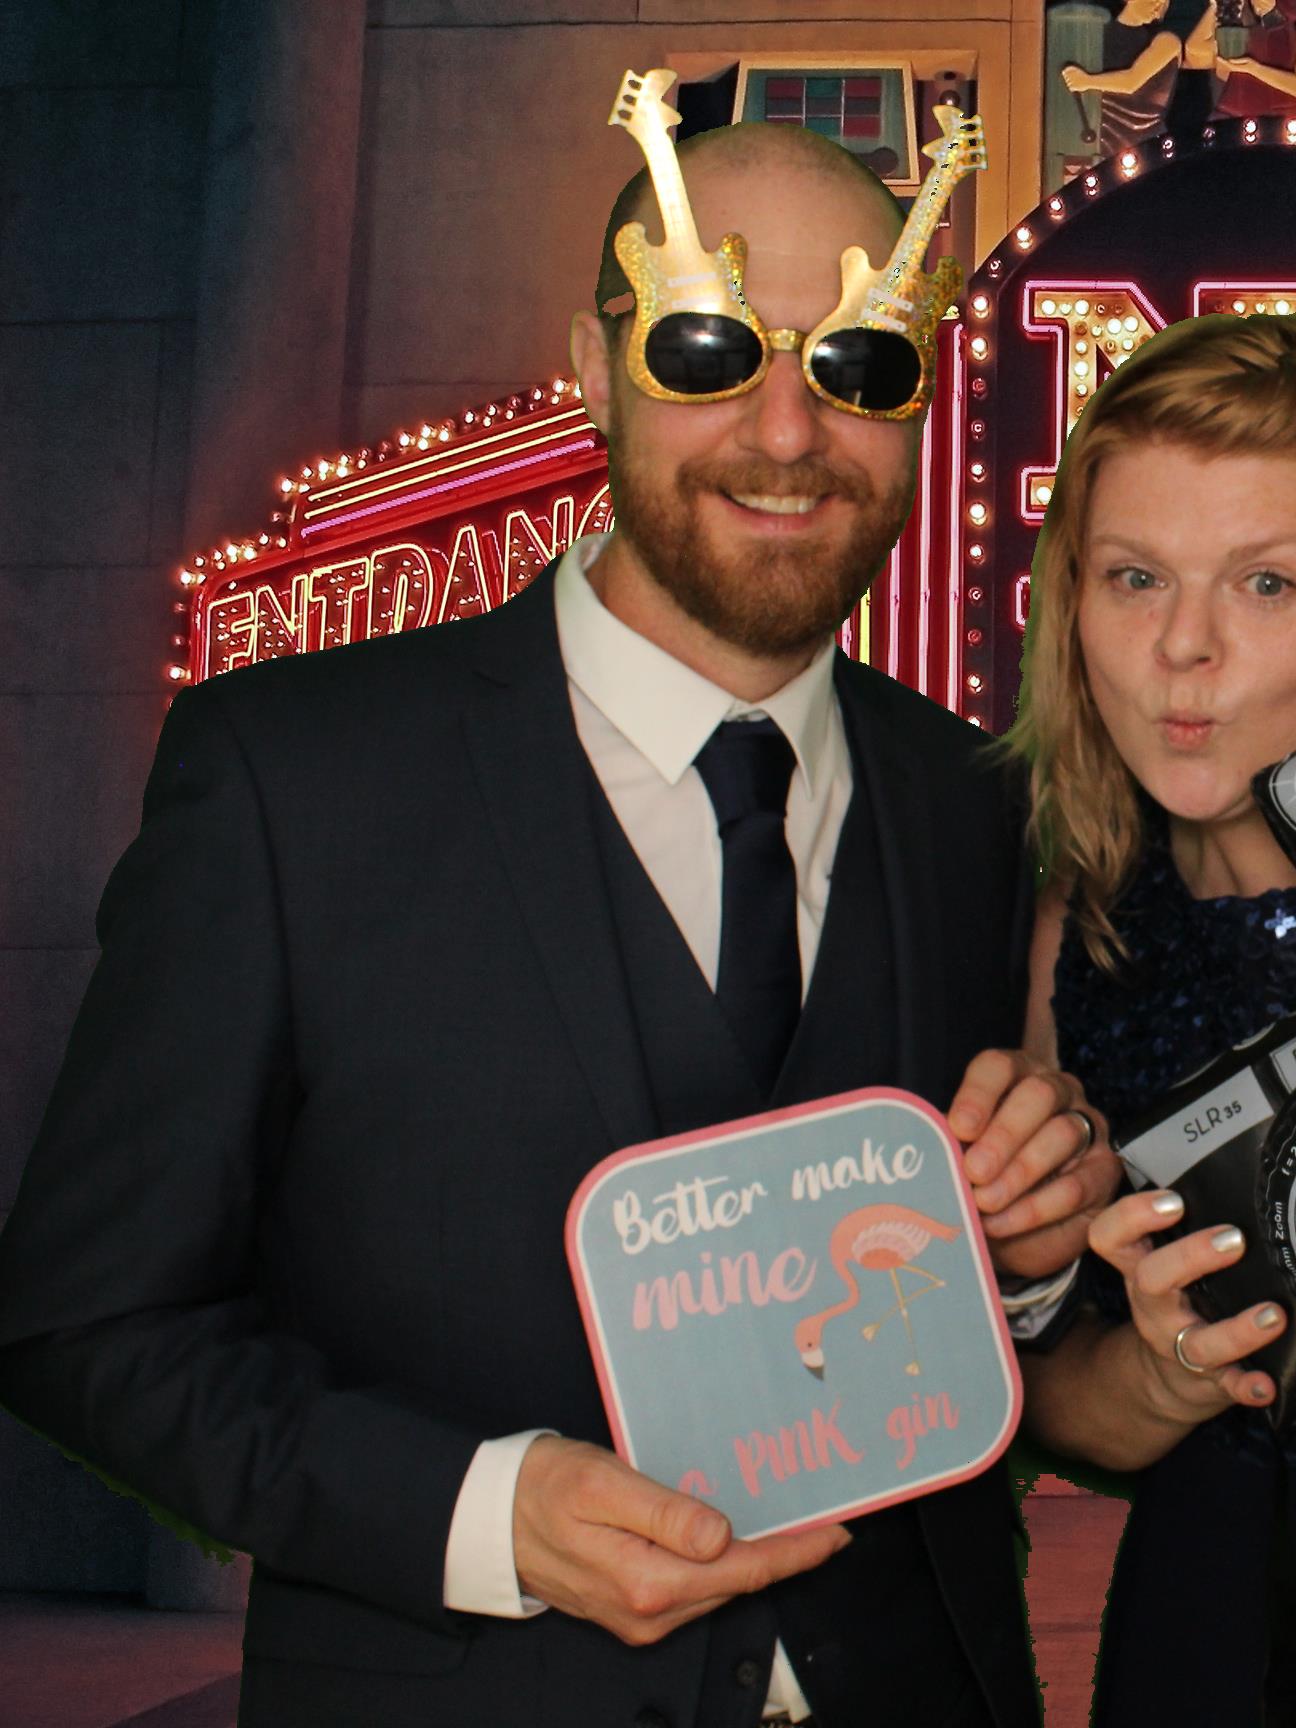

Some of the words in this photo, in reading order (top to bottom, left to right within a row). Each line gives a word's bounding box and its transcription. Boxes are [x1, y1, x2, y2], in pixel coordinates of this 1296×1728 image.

[203, 480, 616, 685] ENTRAN
[1183, 1106, 1223, 1143] SLR
[1225, 1100, 1243, 1120] 35
[613, 1176, 768, 1255] Better
[792, 1138, 924, 1201] make
[633, 1247, 817, 1331] mine
[886, 1392, 960, 1471] gin
